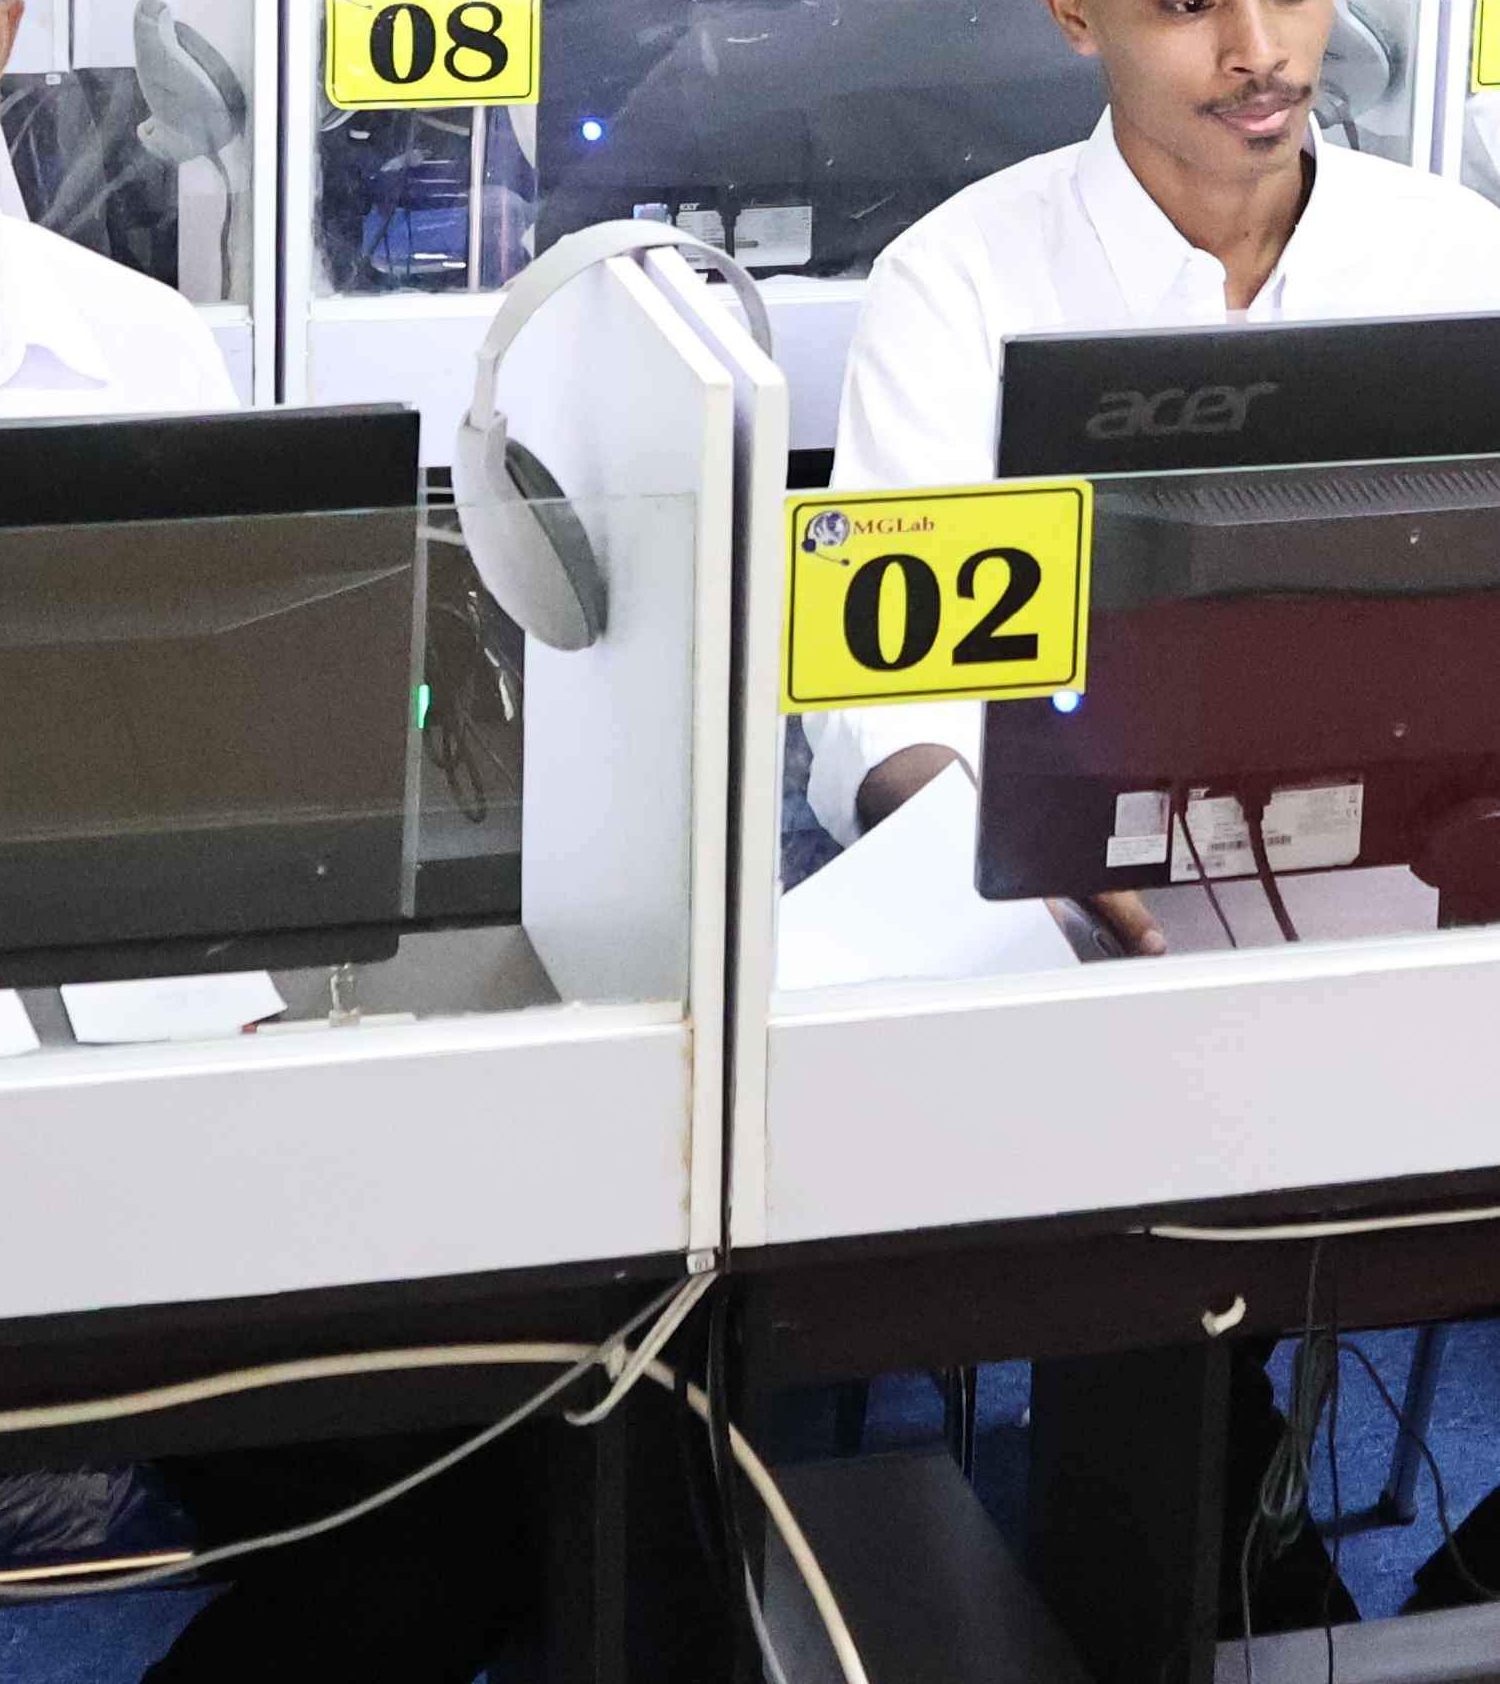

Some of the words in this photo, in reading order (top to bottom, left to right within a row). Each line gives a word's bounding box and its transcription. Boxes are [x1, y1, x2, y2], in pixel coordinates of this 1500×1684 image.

[368, 0, 509, 84] 08
[1085, 380, 1281, 440] acer
[852, 515, 936, 538] MGLab
[842, 547, 1043, 673] 02
